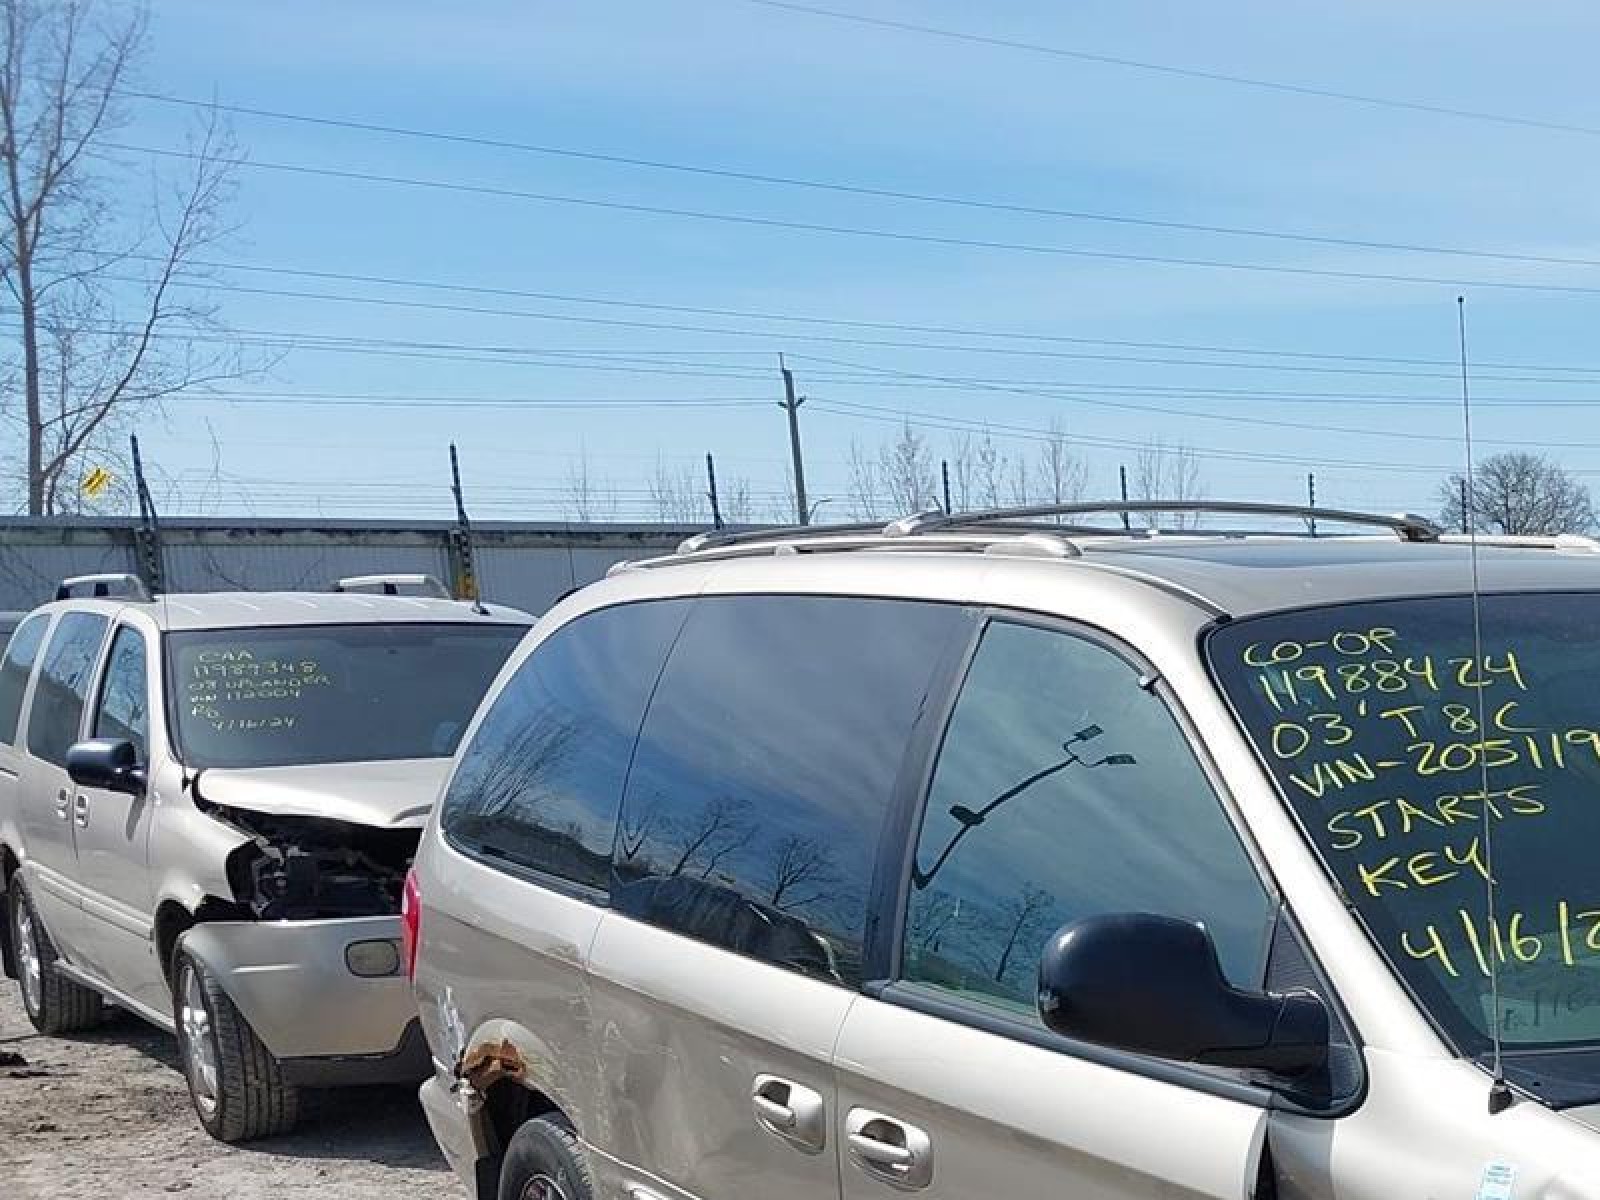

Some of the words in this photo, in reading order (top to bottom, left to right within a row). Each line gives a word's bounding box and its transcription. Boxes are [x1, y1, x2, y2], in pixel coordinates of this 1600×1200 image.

[1259, 651, 1527, 712] 11988424
[1327, 785, 1546, 849] STARTS
[1357, 836, 1499, 897] KEY
